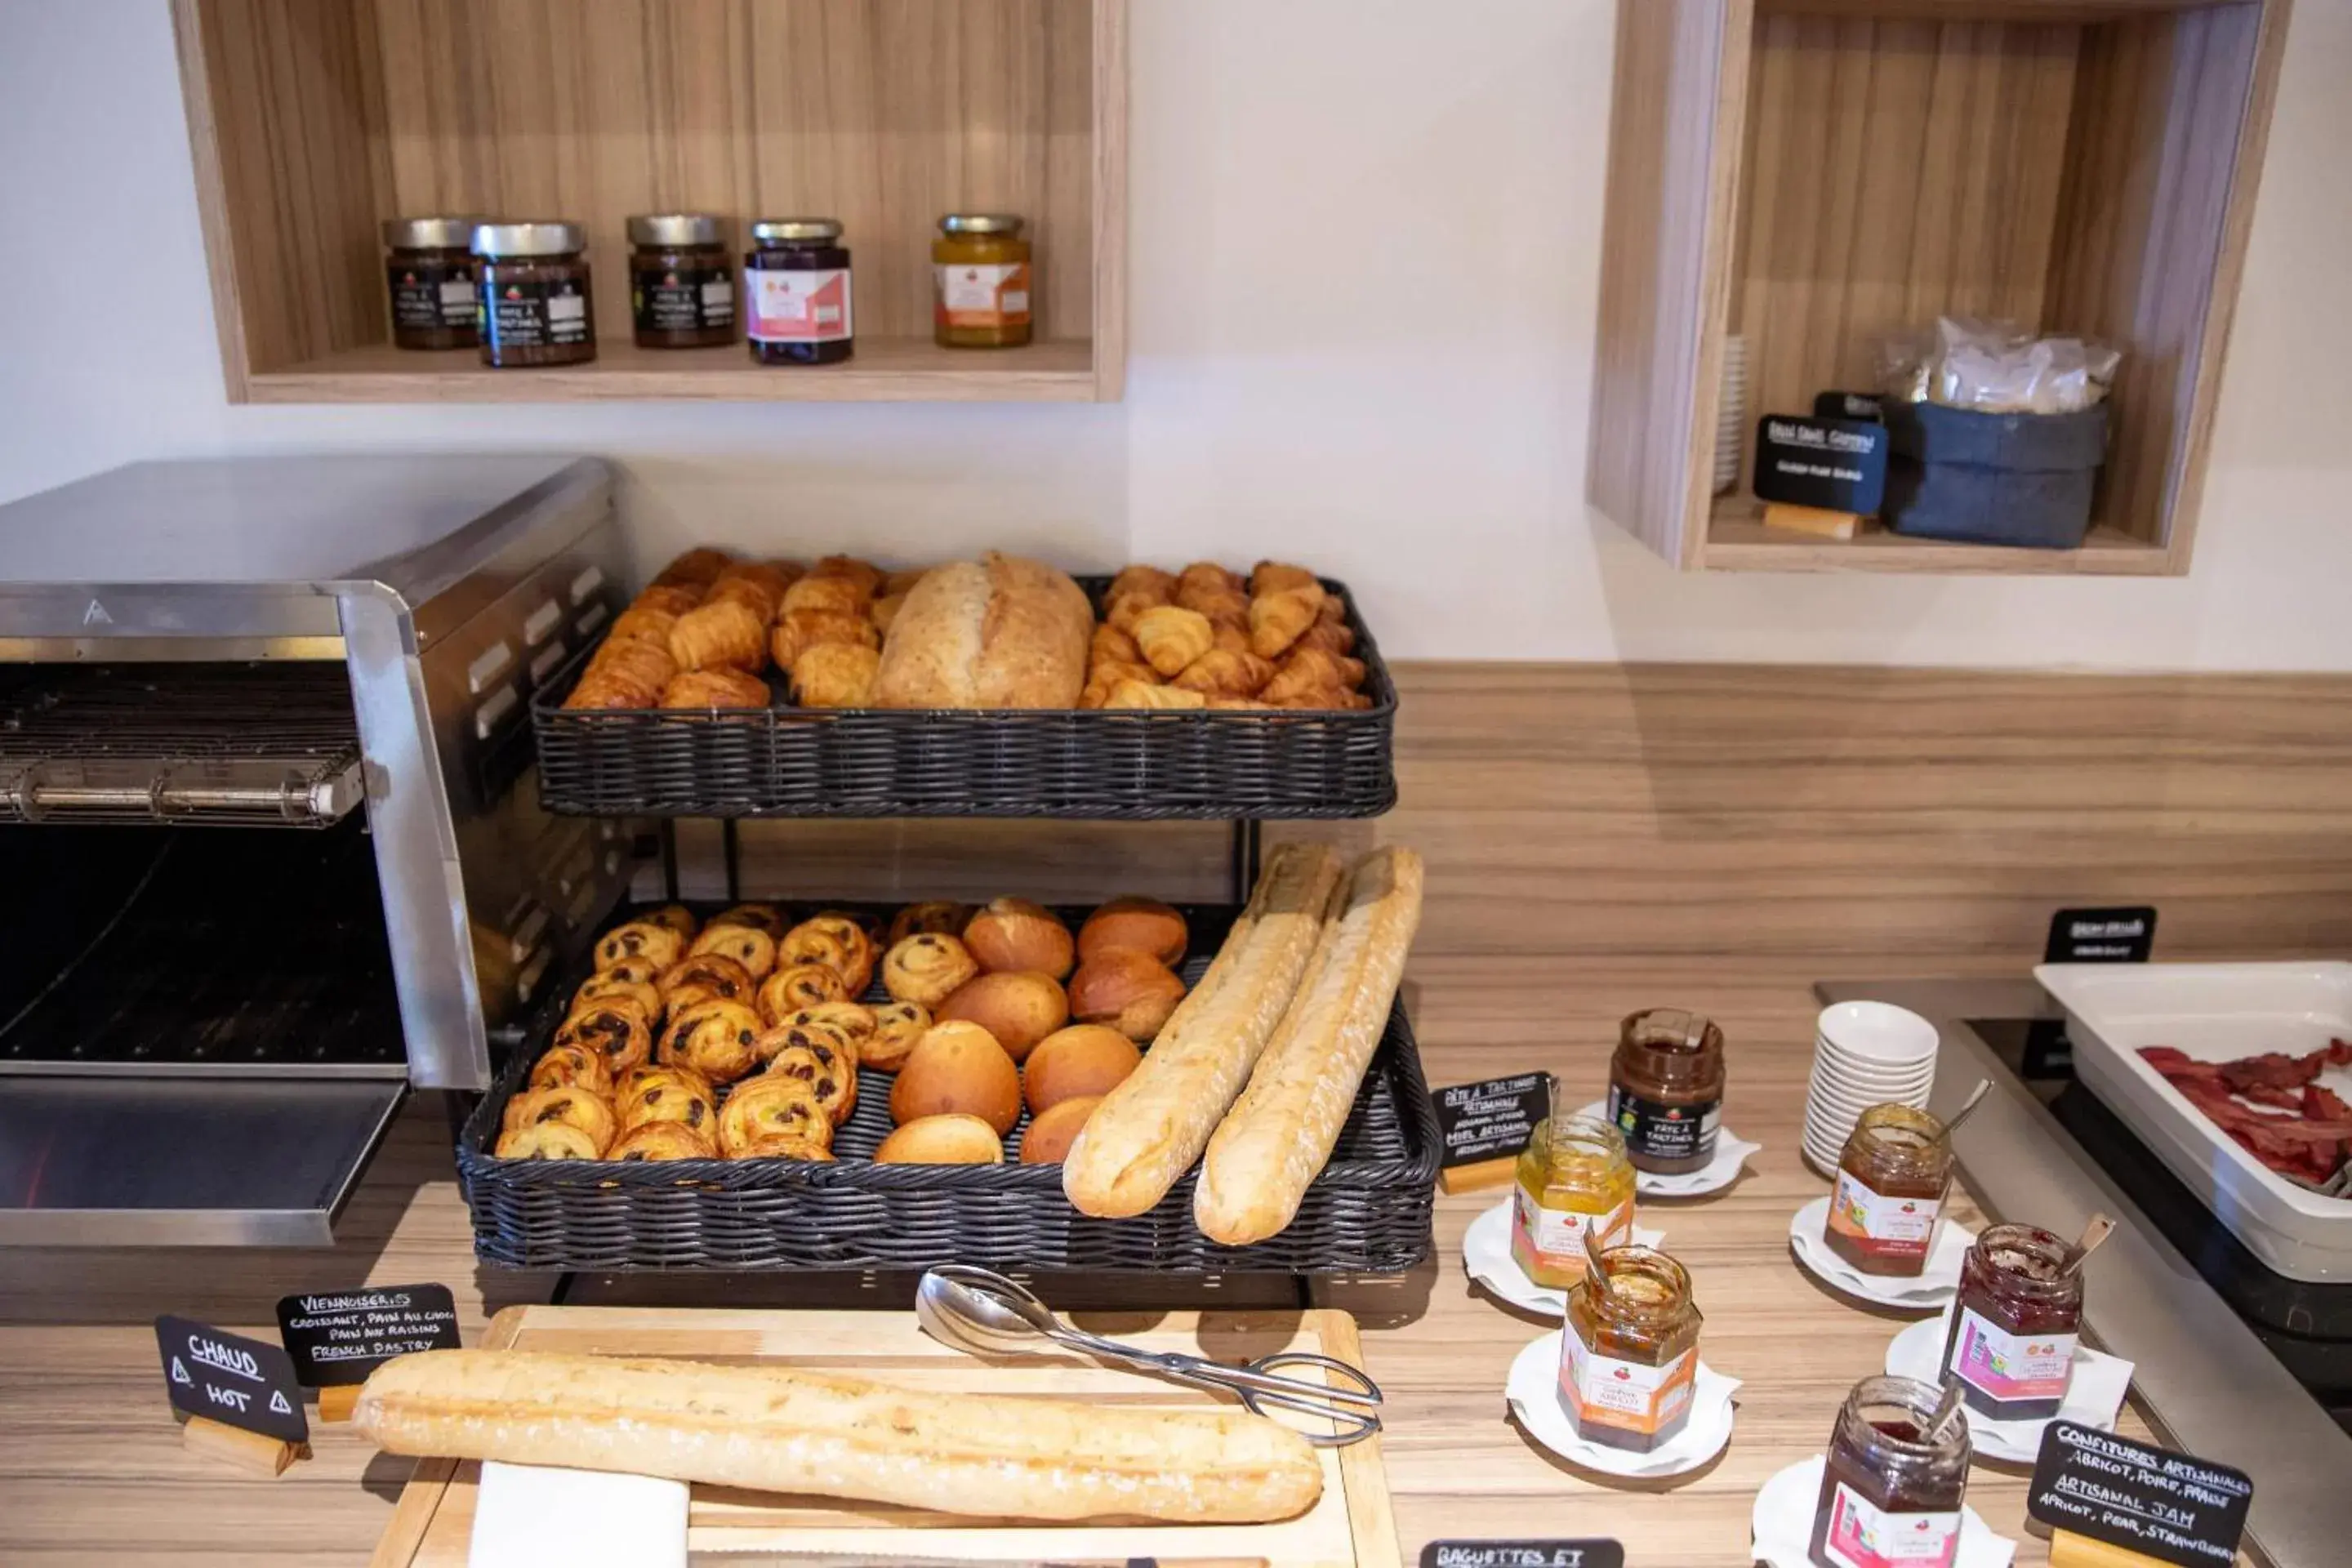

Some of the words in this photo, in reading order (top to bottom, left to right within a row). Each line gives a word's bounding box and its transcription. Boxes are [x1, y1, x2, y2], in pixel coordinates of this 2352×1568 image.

[368, 1312, 400, 1325] PAIN
[330, 1329, 361, 1340] PAIN
[389, 1324, 440, 1336] RAISINS
[189, 1334, 258, 1375] CHAUD
[311, 1344, 366, 1359] FRENCH
[373, 1340, 433, 1356] PASTRY
[206, 1383, 251, 1412] HOT
[2056, 1426, 2158, 1468] CONFITURES
[2055, 1474, 2144, 1511] ARTISANAL
[2151, 1501, 2196, 1530] JAM
[1437, 1547, 1544, 1566] BAGUETTES
[1554, 1549, 1584, 1566] ET
